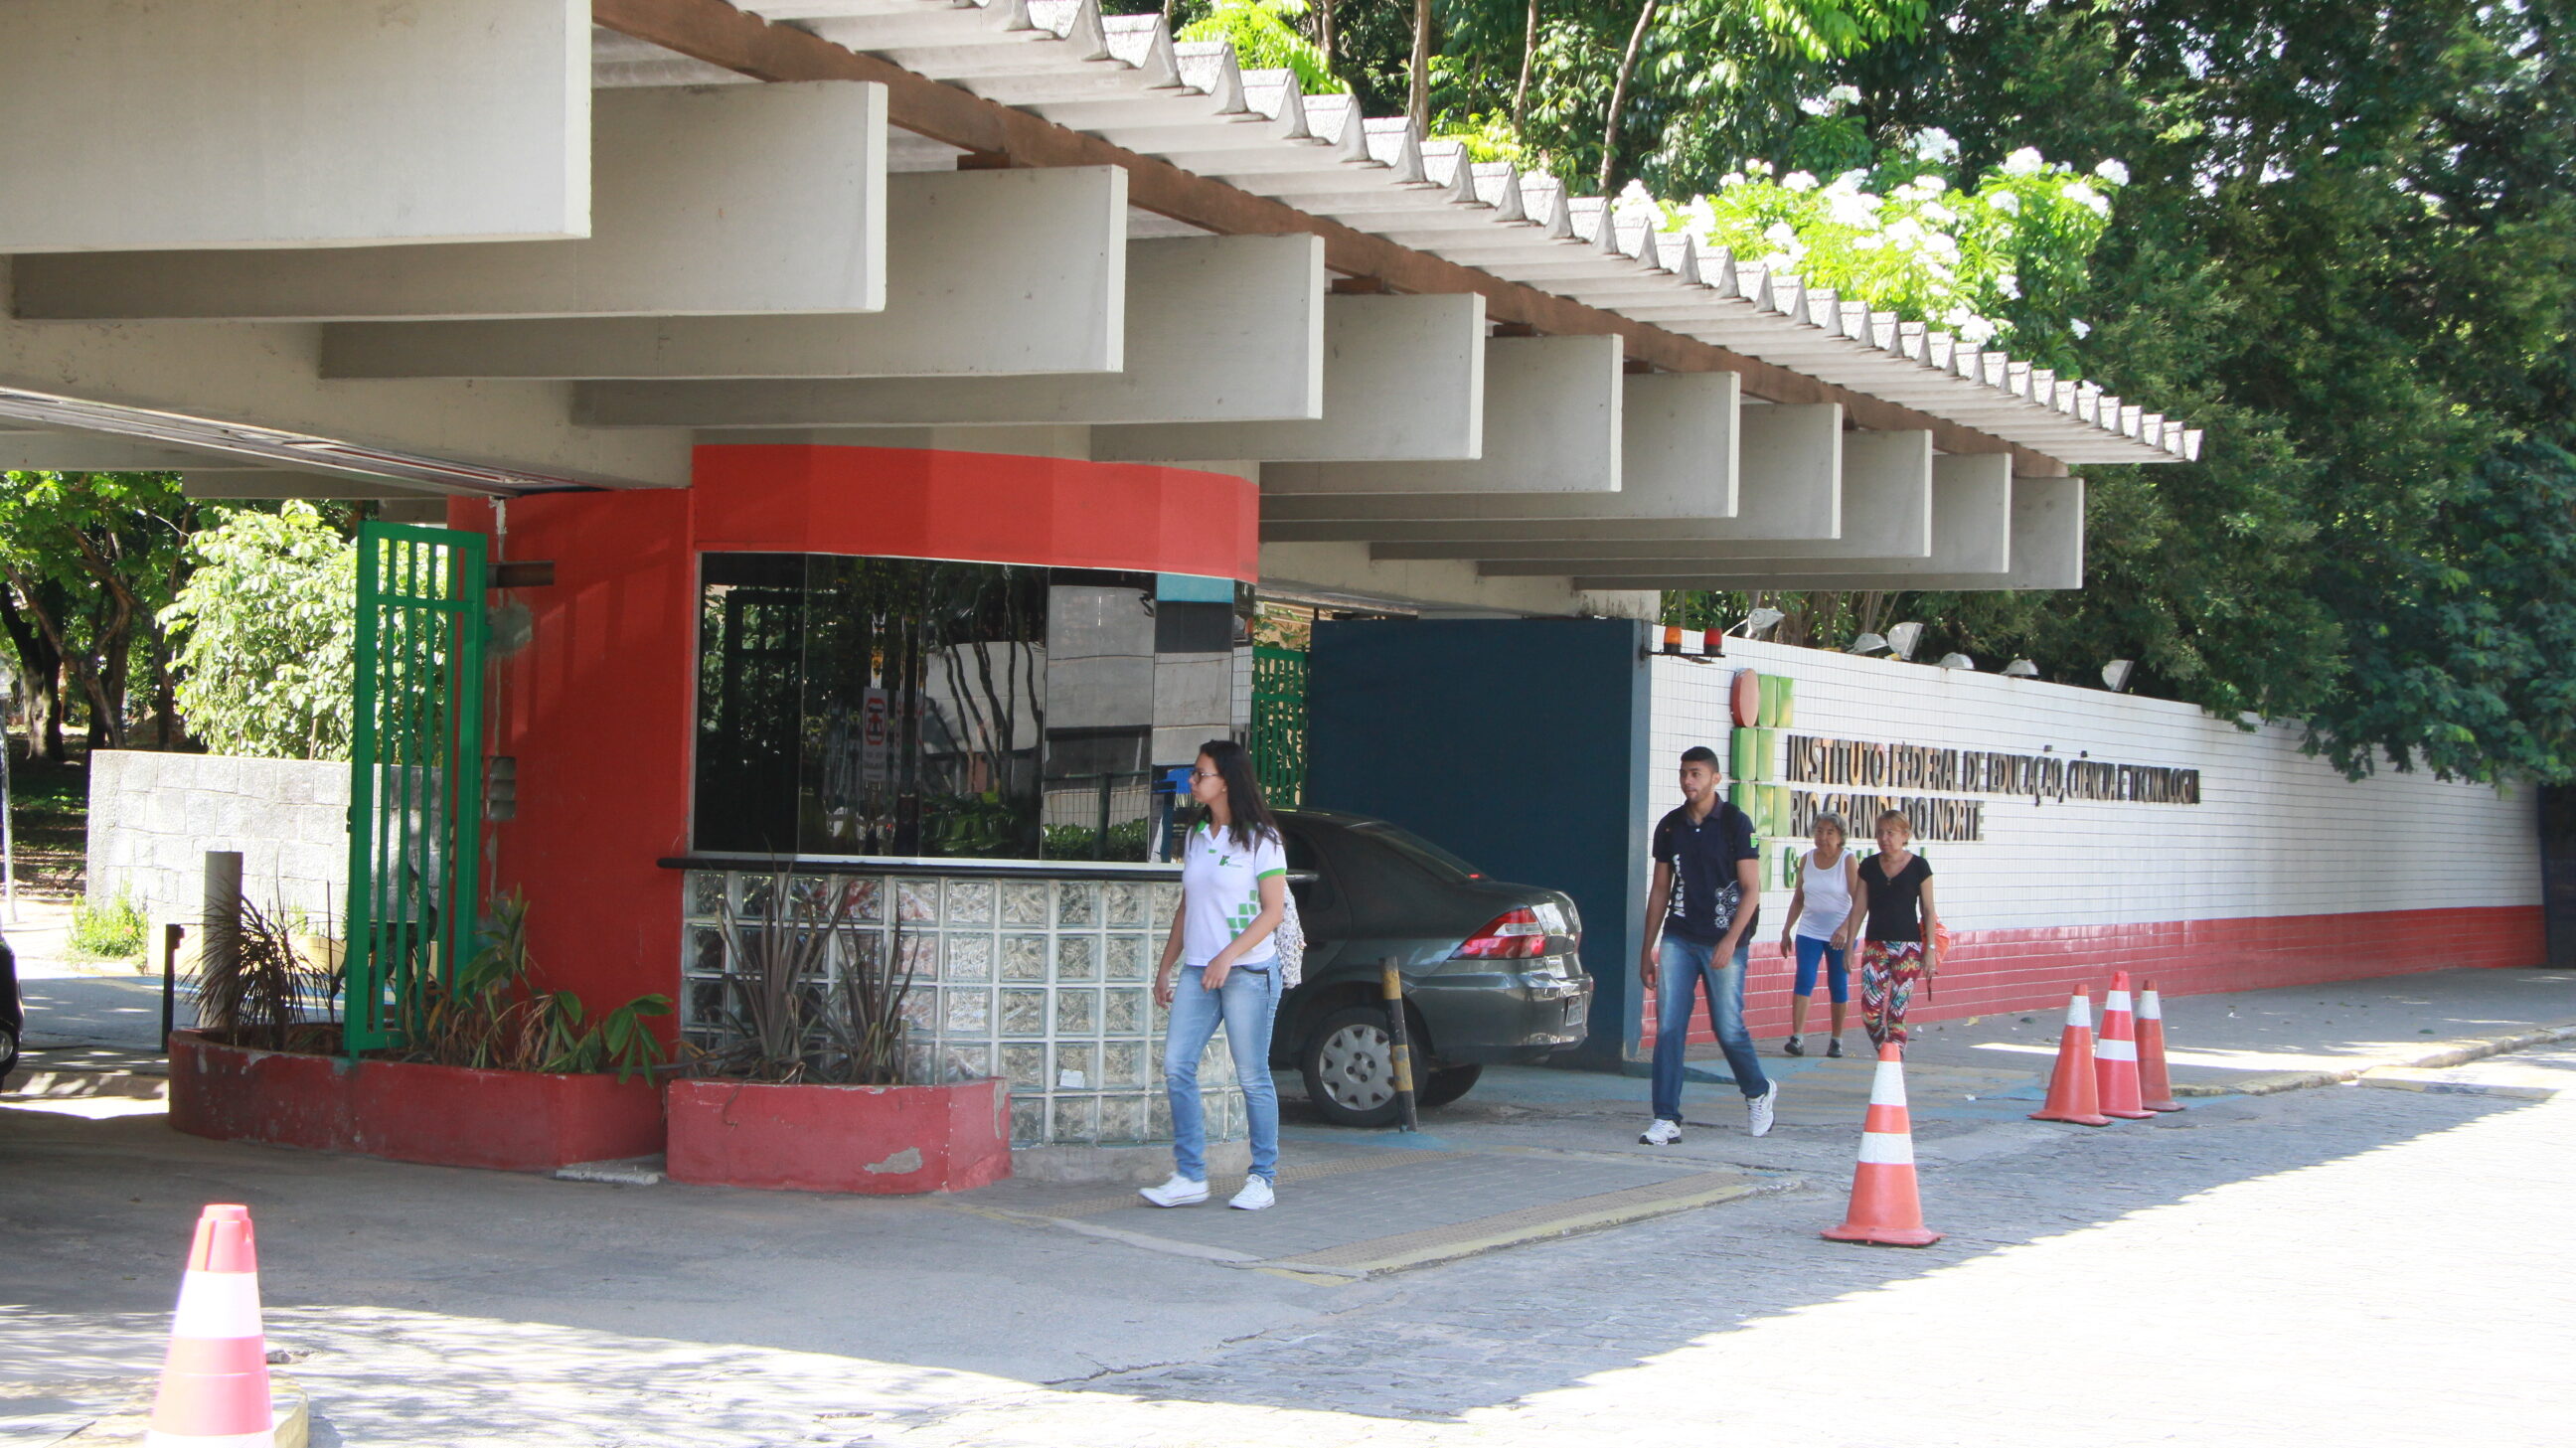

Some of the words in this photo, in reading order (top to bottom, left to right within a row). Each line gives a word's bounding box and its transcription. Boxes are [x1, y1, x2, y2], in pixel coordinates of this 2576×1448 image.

[1786, 734, 1886, 788] INSTITUTO
[1888, 743, 1962, 792] FEDERAL
[1963, 750, 1986, 793] DE
[2118, 763, 2131, 801] E
[1790, 790, 1820, 838] RIO
[1901, 796, 1929, 840] DO
[1930, 798, 1985, 841] NORTE
